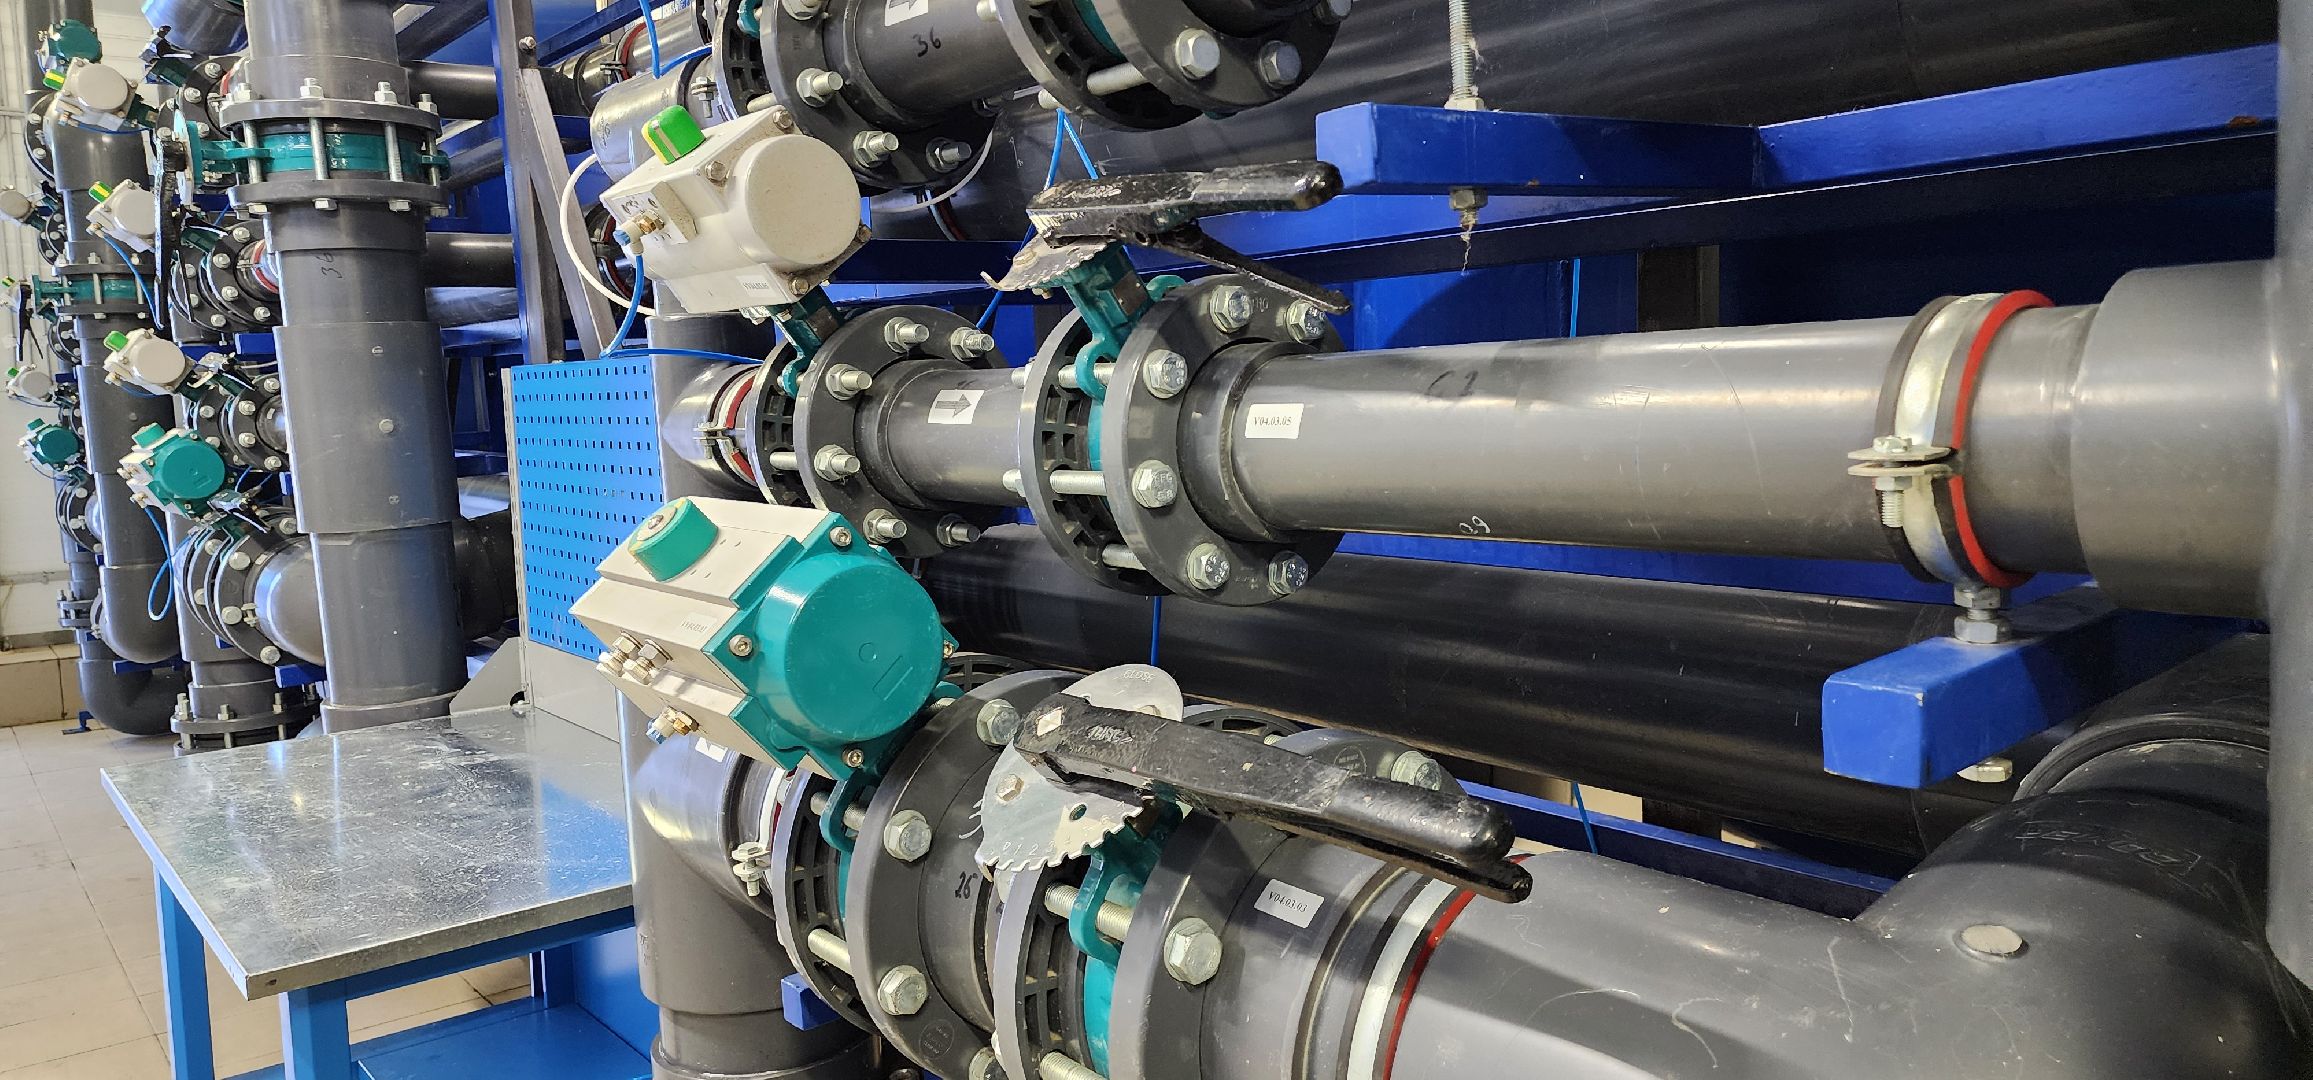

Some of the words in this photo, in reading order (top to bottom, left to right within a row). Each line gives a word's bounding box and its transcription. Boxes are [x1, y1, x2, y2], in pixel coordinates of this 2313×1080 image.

[912, 26, 942, 58] 36
[1254, 416, 1293, 426] V04.03.05
[1268, 891, 1308, 913] V04.03.03
